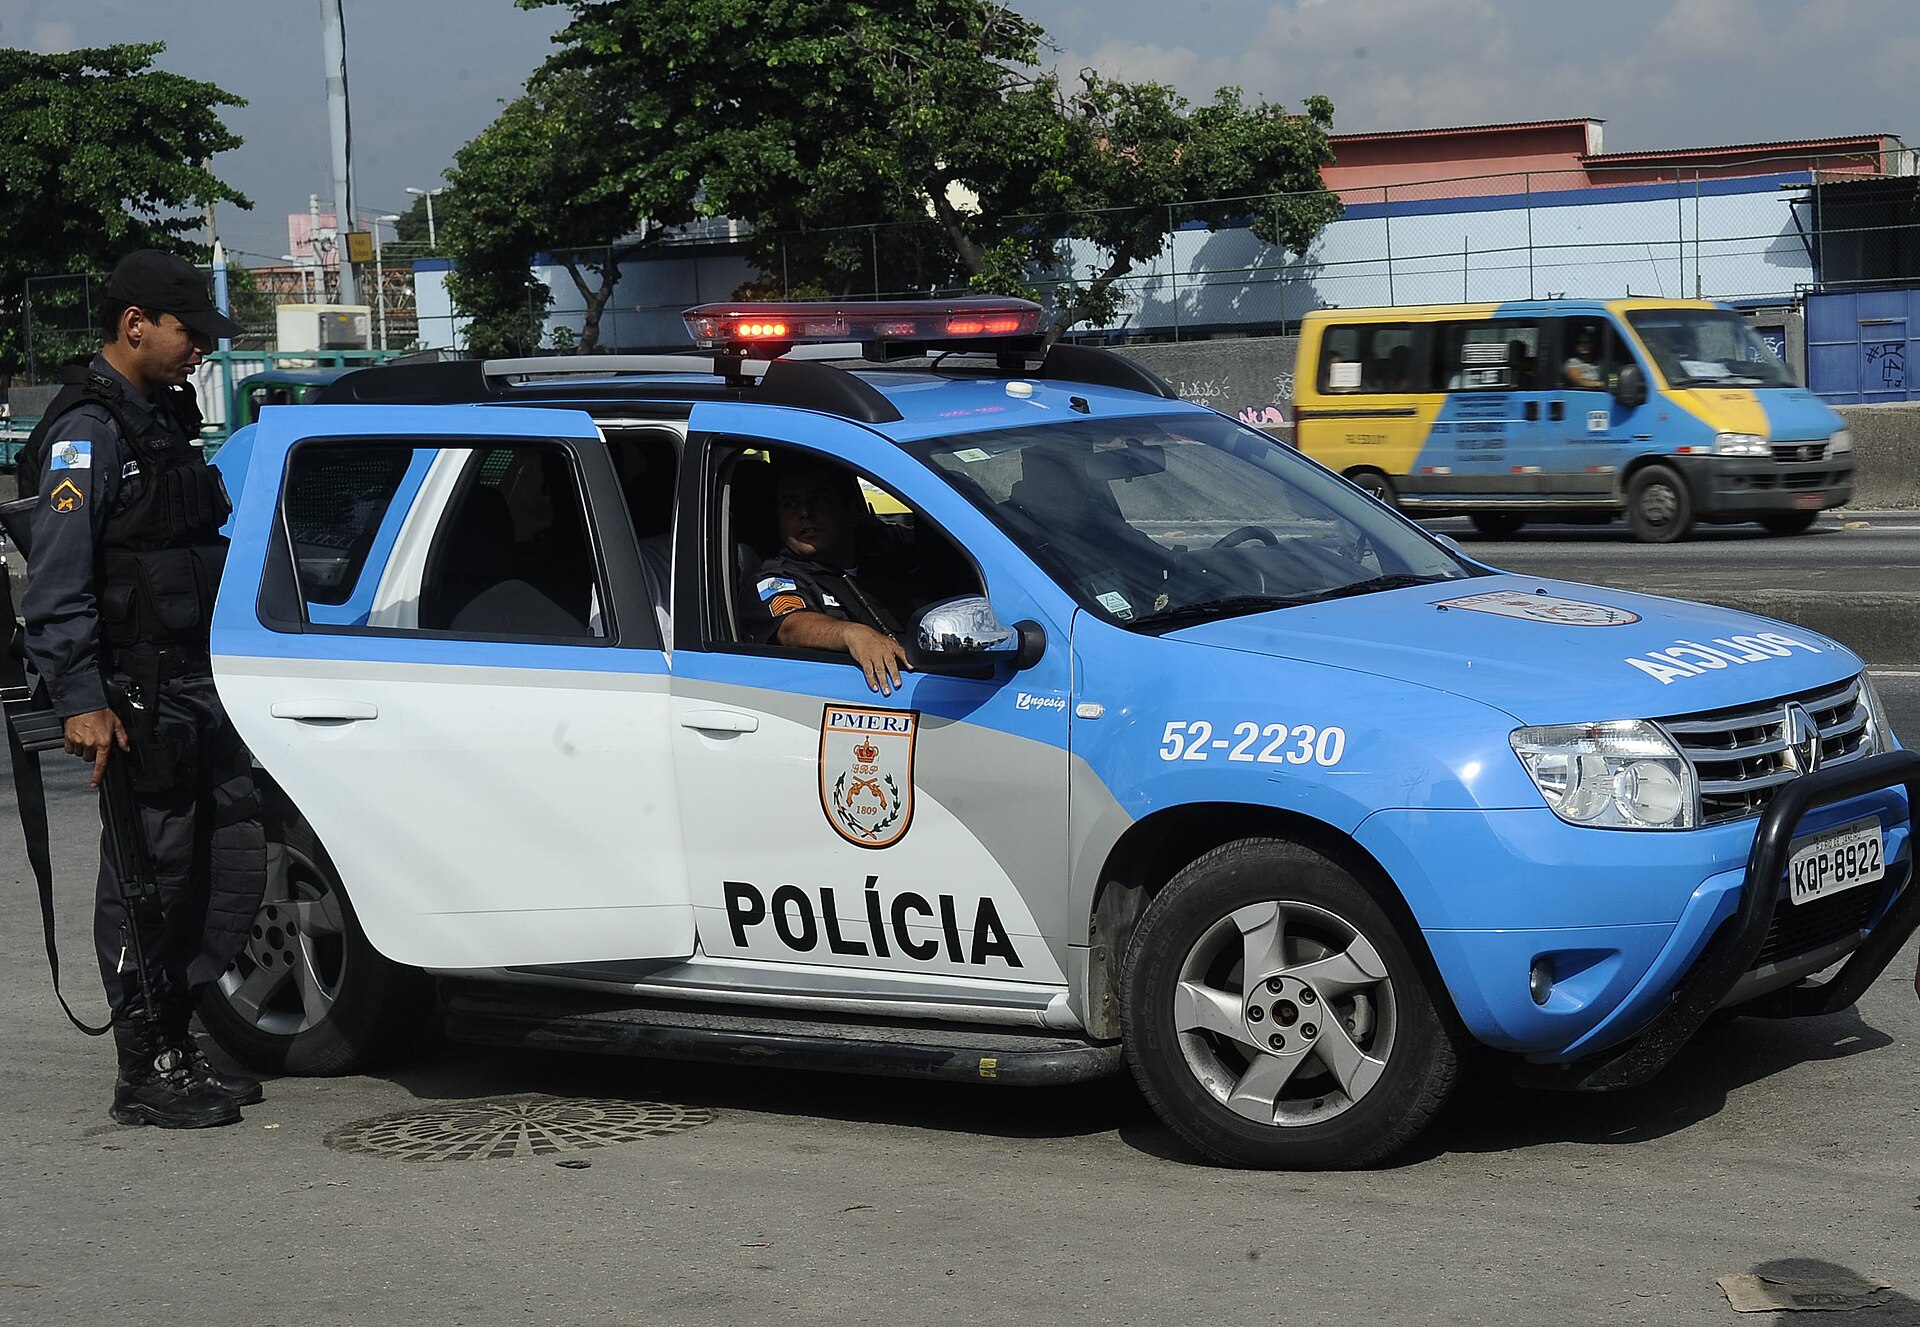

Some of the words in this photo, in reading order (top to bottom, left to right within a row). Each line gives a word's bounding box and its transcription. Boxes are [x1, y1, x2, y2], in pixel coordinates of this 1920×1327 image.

[830, 712, 912, 733] PMERJ
[1159, 720, 1346, 767] 52-2230
[856, 805, 878, 816] 1809
[723, 875, 1024, 968] POLÍCIA
